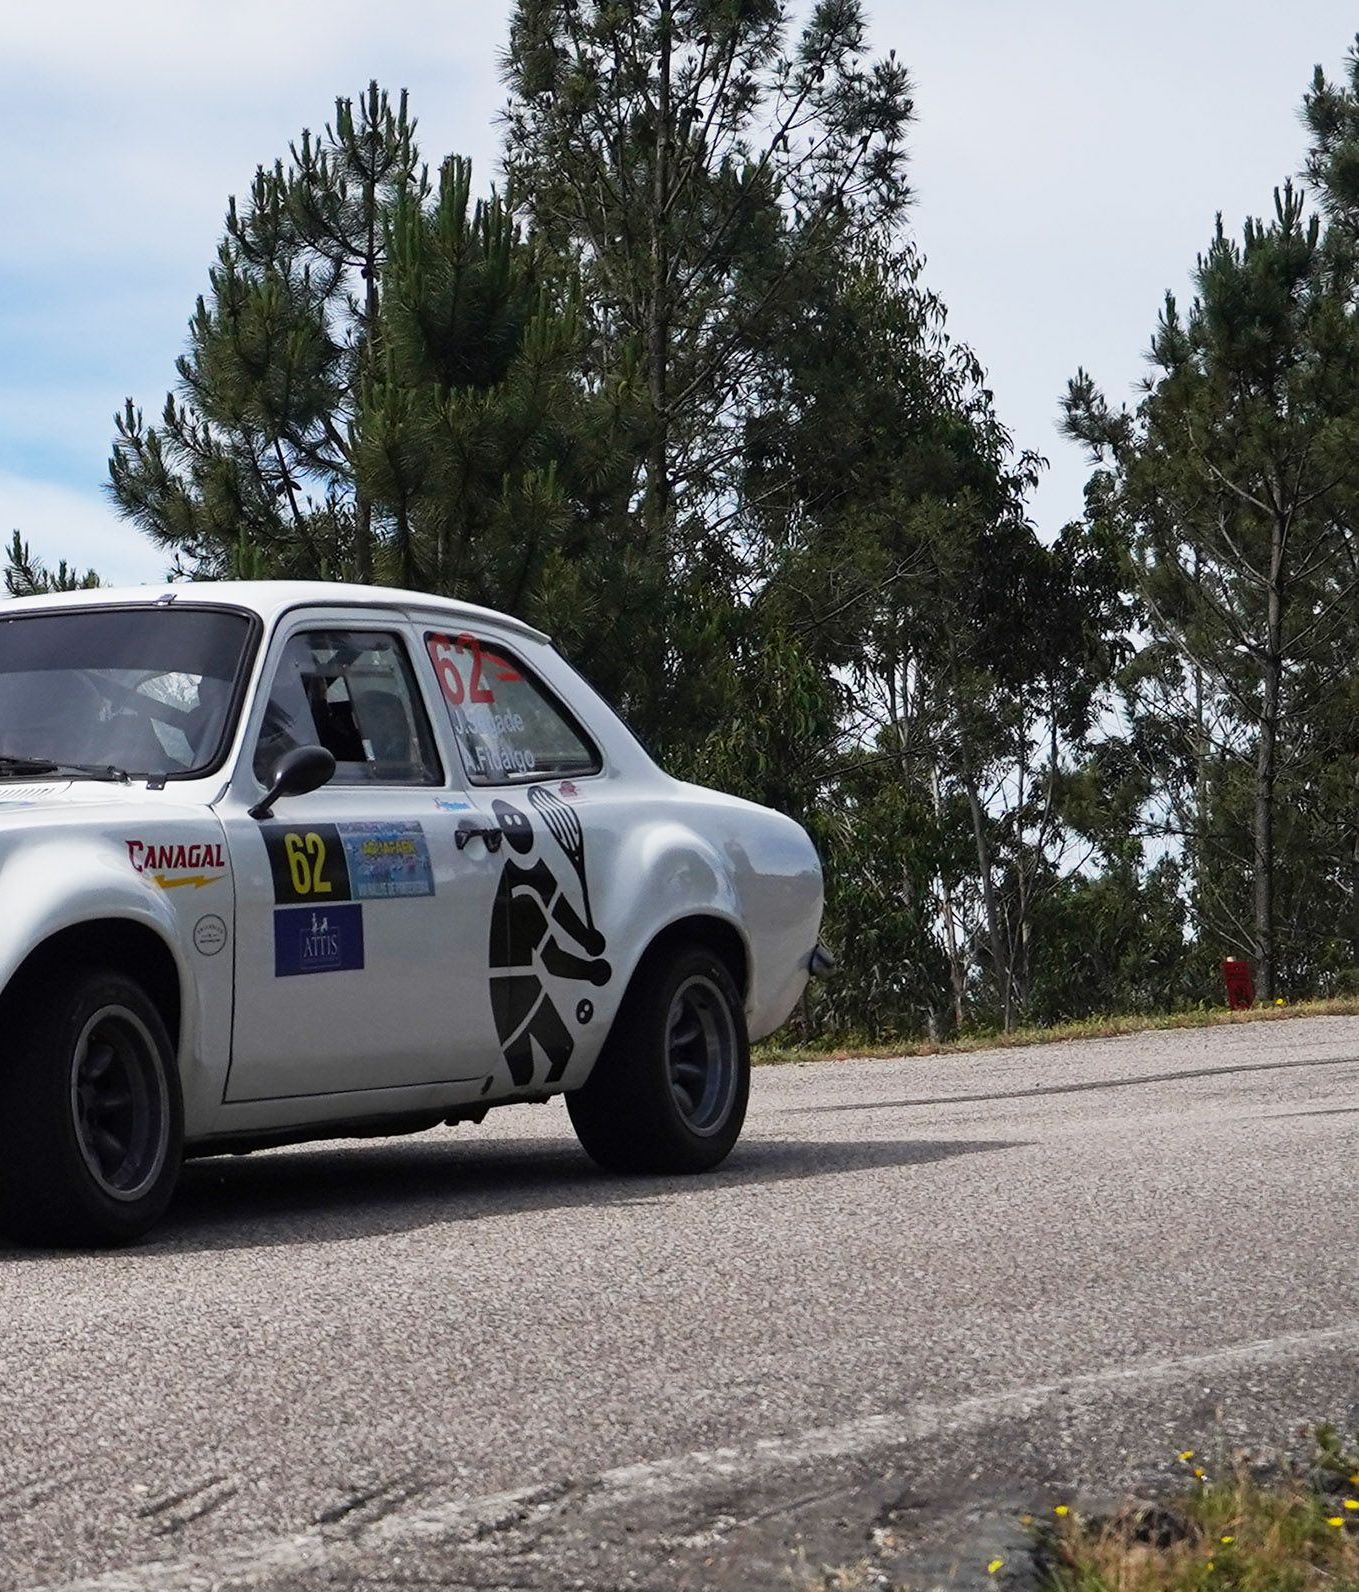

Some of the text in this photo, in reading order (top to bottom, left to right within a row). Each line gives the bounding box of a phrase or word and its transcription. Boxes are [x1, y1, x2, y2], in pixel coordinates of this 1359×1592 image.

[430, 632, 495, 705] 62
[463, 746, 535, 774] A.Fidalgo
[125, 840, 225, 873] CANAGAL
[284, 832, 332, 894] 62
[303, 934, 338, 958] ATTIS
